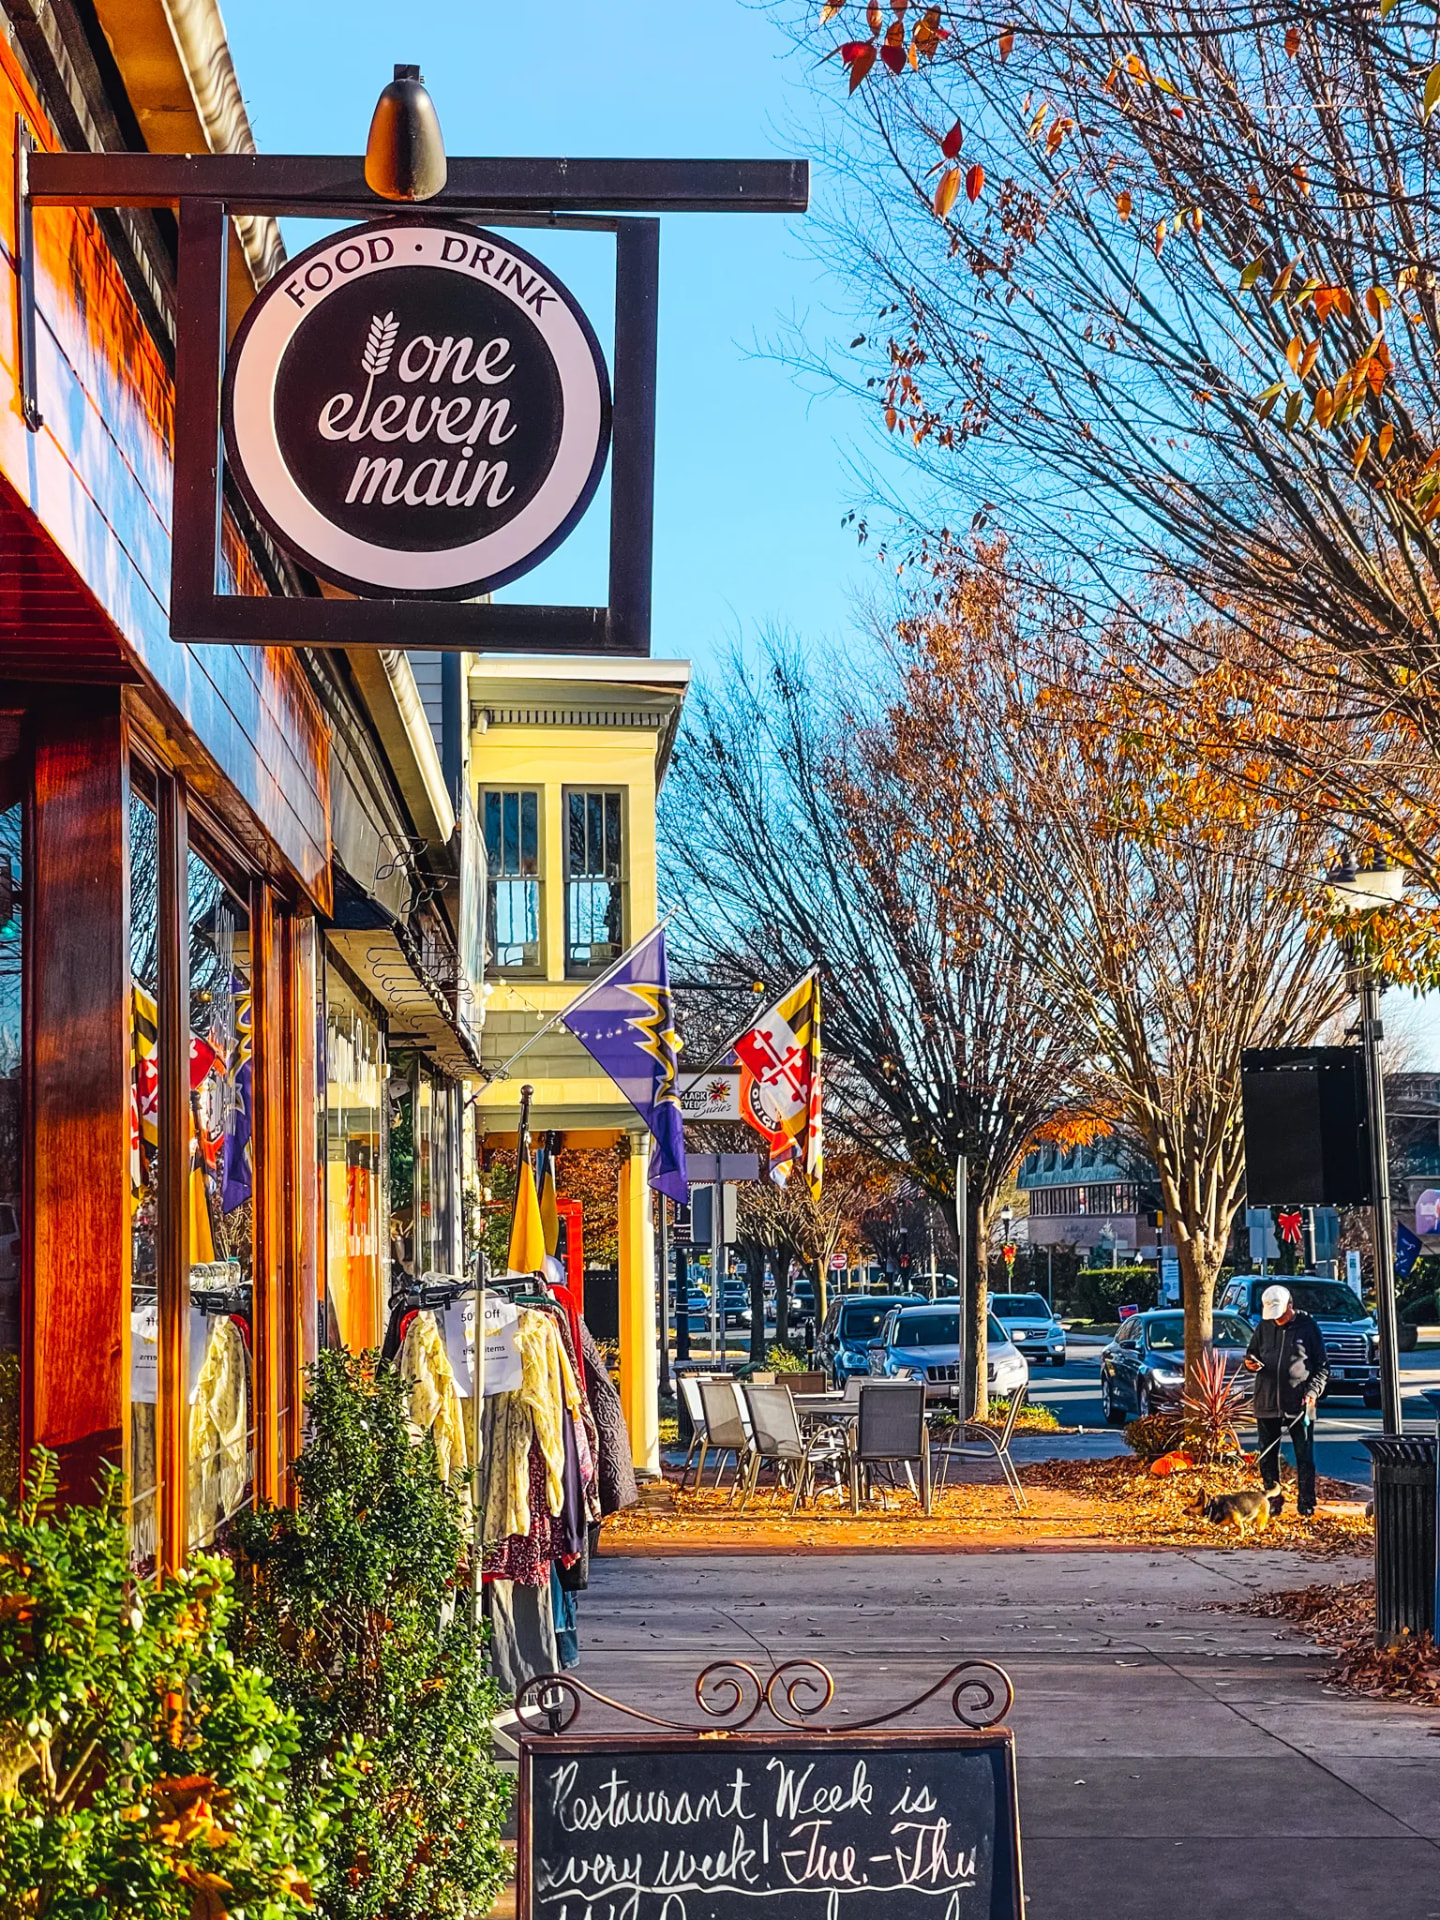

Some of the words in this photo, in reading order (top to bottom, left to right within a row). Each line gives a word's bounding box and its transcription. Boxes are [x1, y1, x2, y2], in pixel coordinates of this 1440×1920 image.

[284, 236, 394, 309] FOOD
[440, 237, 558, 317] DRINK
[398, 335, 516, 385] one
[318, 374, 517, 446] eleven
[344, 446, 516, 508] main
[485, 1309, 500, 1319] Off
[549, 1761, 756, 1832] Restaurant
[765, 1757, 873, 1820] Week
[889, 1768, 937, 1813] is
